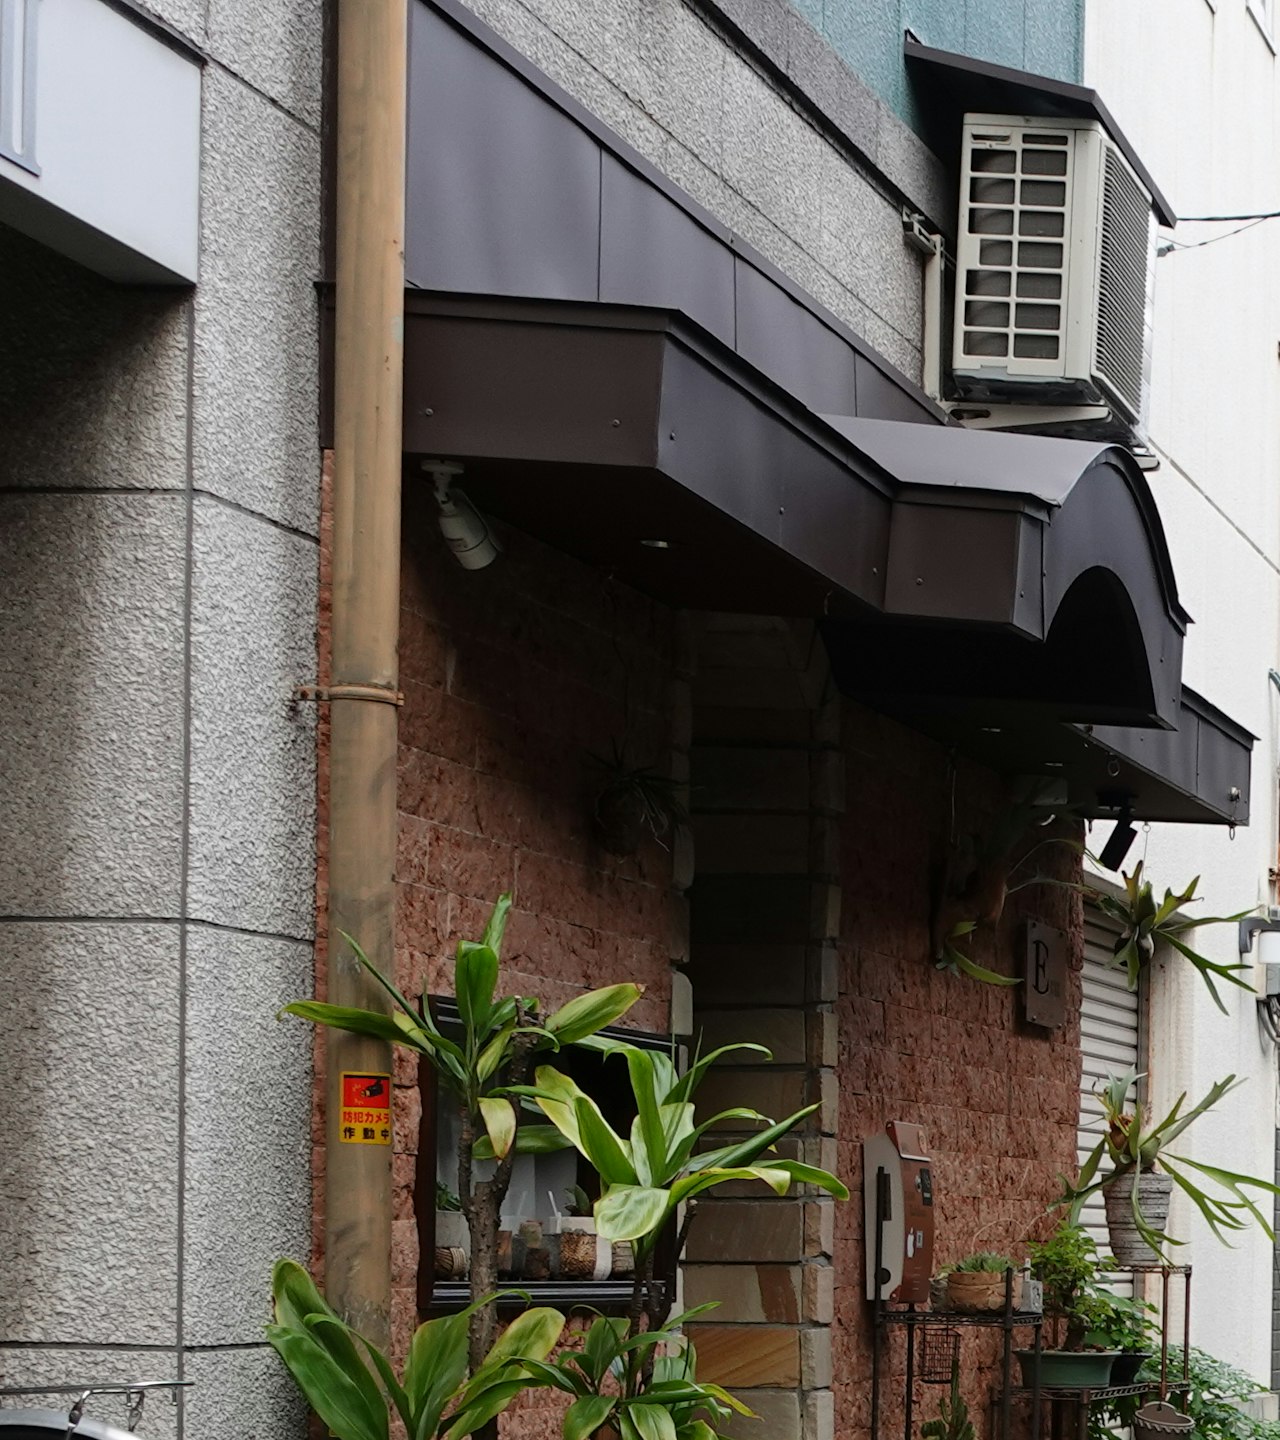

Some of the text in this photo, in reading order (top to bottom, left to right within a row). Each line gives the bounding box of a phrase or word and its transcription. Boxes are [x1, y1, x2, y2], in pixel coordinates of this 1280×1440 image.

[343, 1111, 389, 1124] 防犯カメラ
[343, 1126, 389, 1141] 作動中
